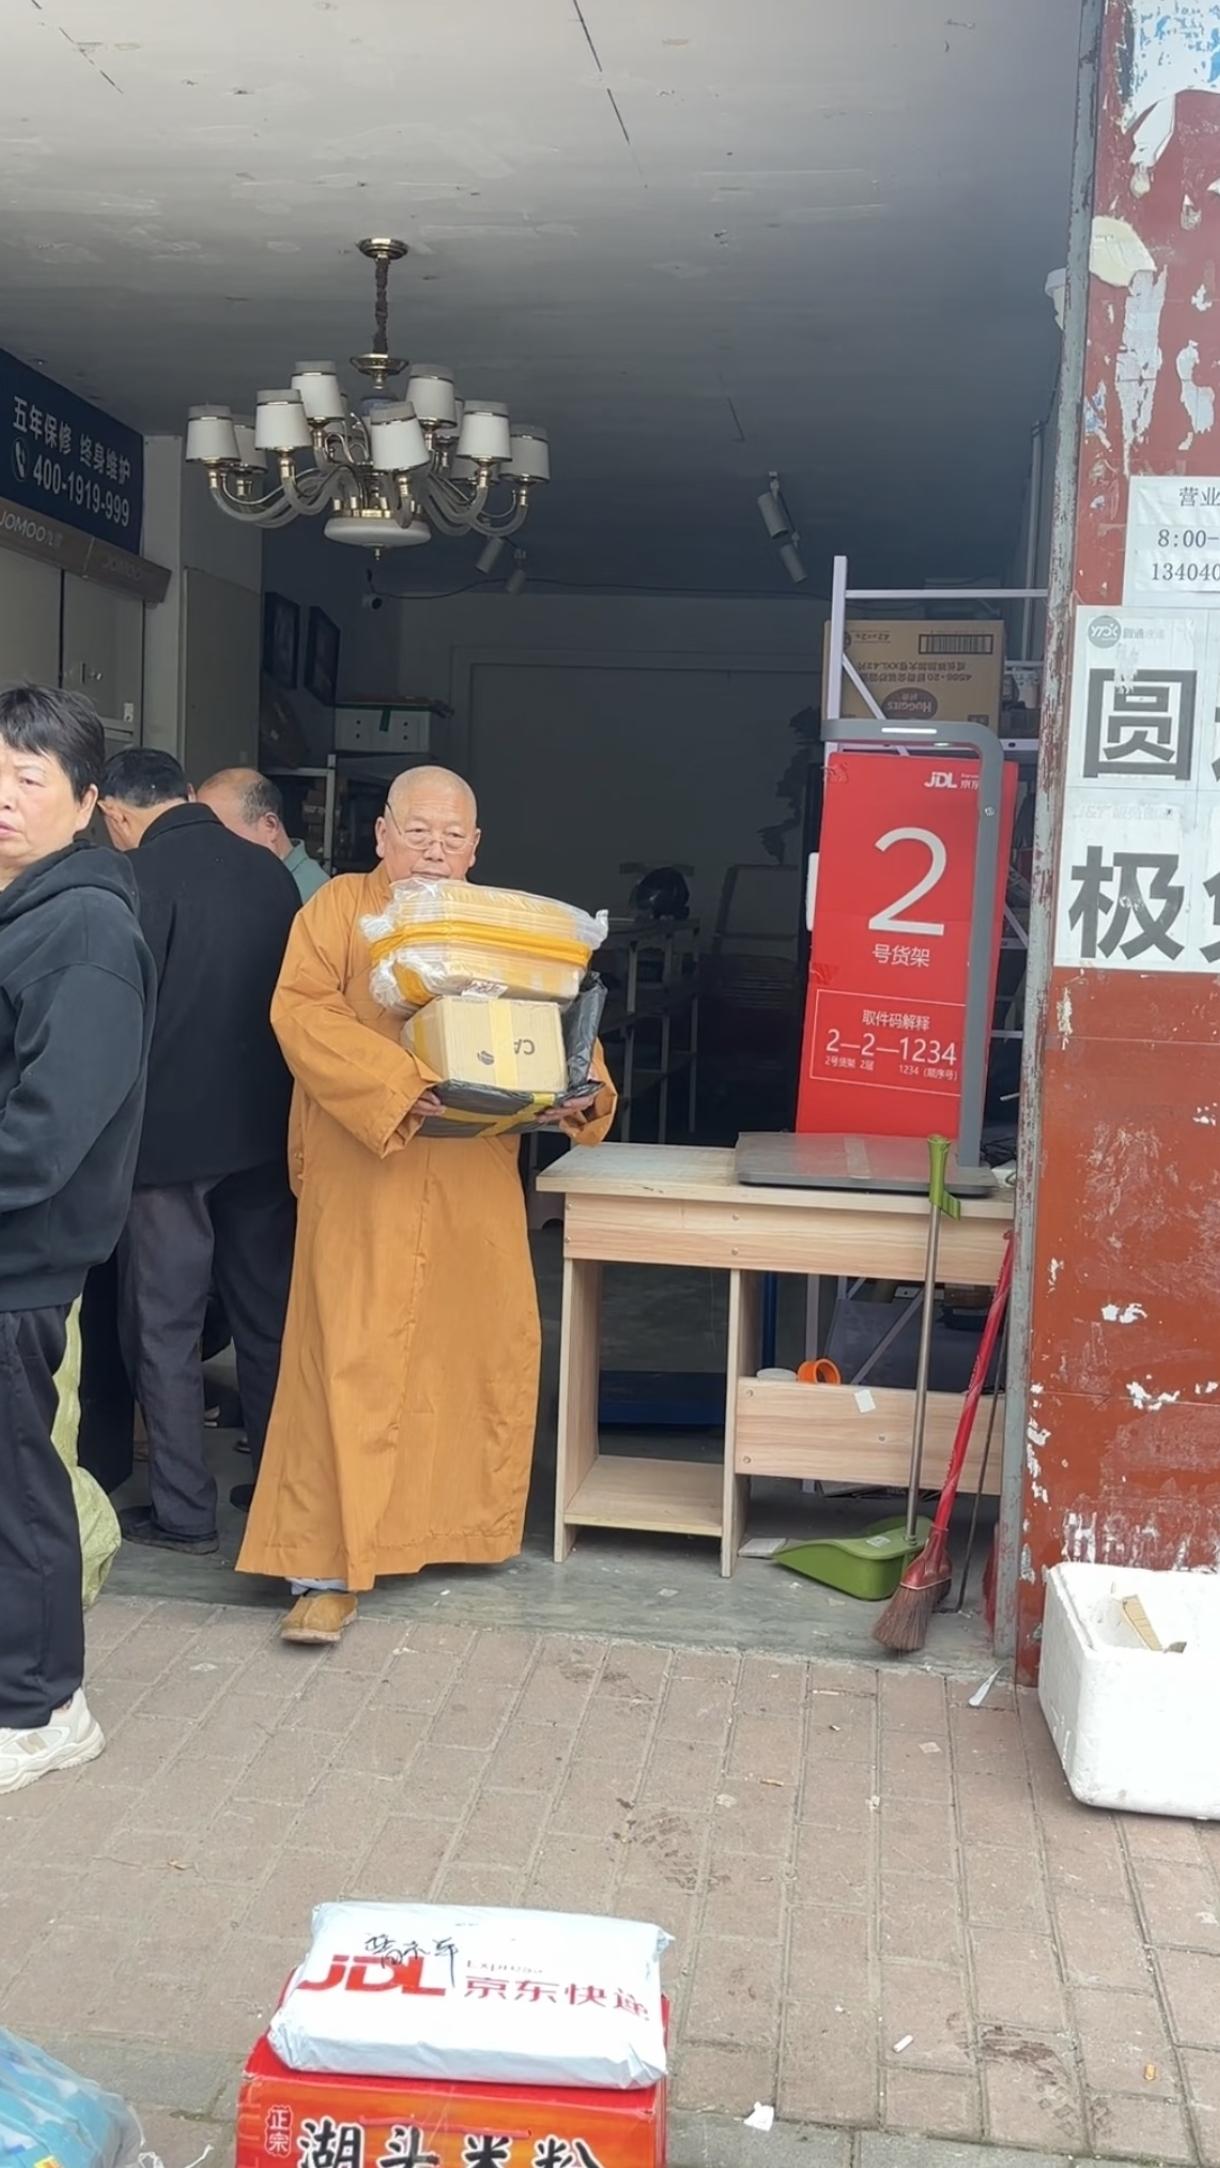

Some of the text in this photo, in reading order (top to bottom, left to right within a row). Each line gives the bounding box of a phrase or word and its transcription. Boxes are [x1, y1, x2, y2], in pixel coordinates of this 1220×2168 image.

[13, 395, 131, 486] 五年保修 终身维护
[33, 453, 130, 528] 400-1919-999
[0, 511, 46, 542] JOMOO
[924, 771, 958, 788] JDL
[868, 827, 947, 936] 2
[872, 943, 931, 968] 号货架
[862, 1009, 931, 1031] 取件码解释
[899, 1064, 919, 1075] 1234
[297, 1954, 650, 2021] JDL 京东快递
[268, 2107, 290, 2154] 正宗
